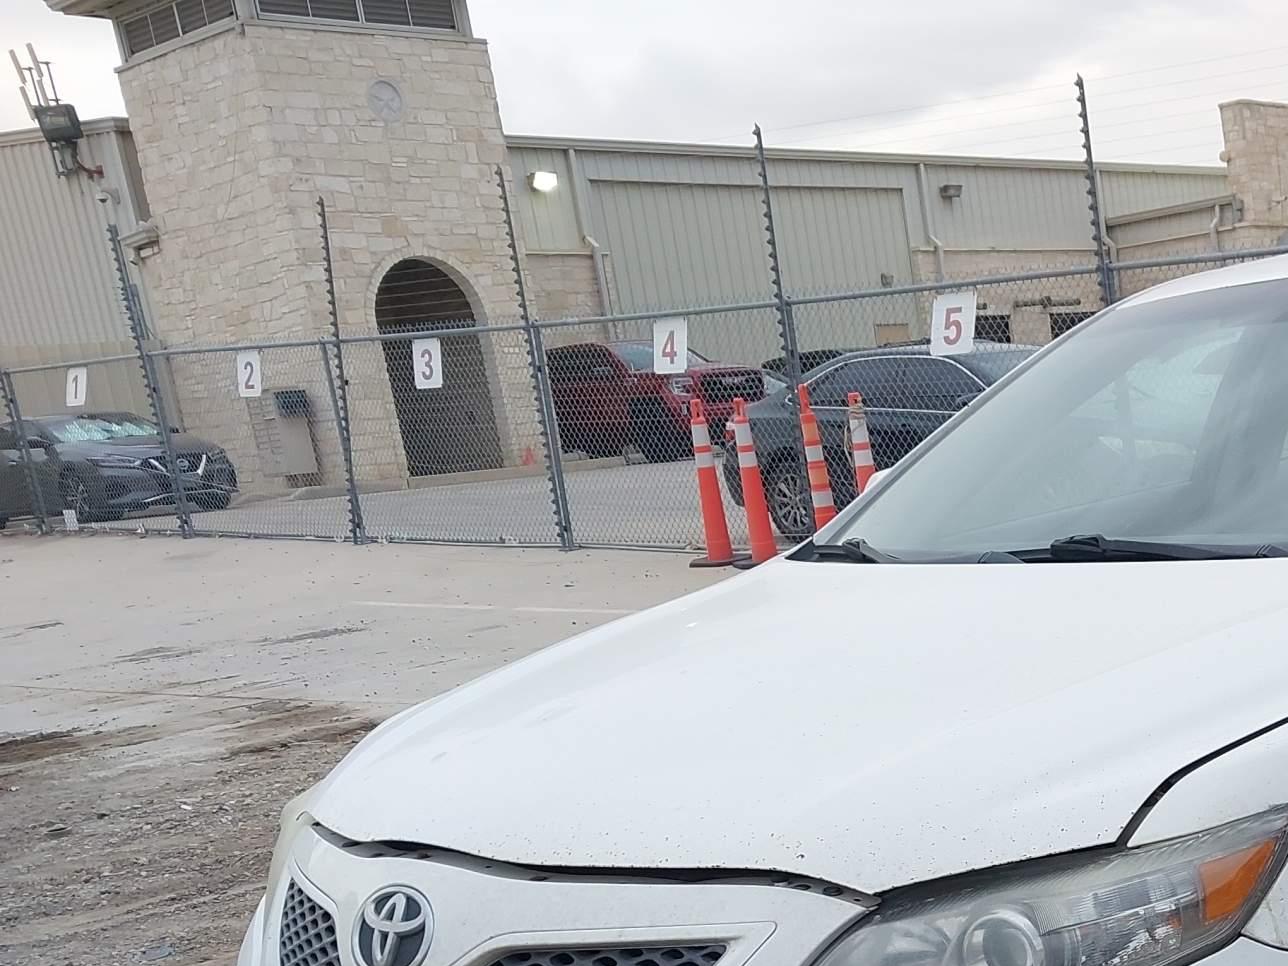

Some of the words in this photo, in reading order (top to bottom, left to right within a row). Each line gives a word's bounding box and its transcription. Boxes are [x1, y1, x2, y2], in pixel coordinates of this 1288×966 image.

[943, 306, 963, 346] 5
[661, 329, 678, 365] 4
[243, 361, 256, 390] 2
[420, 348, 434, 381] 3
[71, 374, 80, 400] 1
